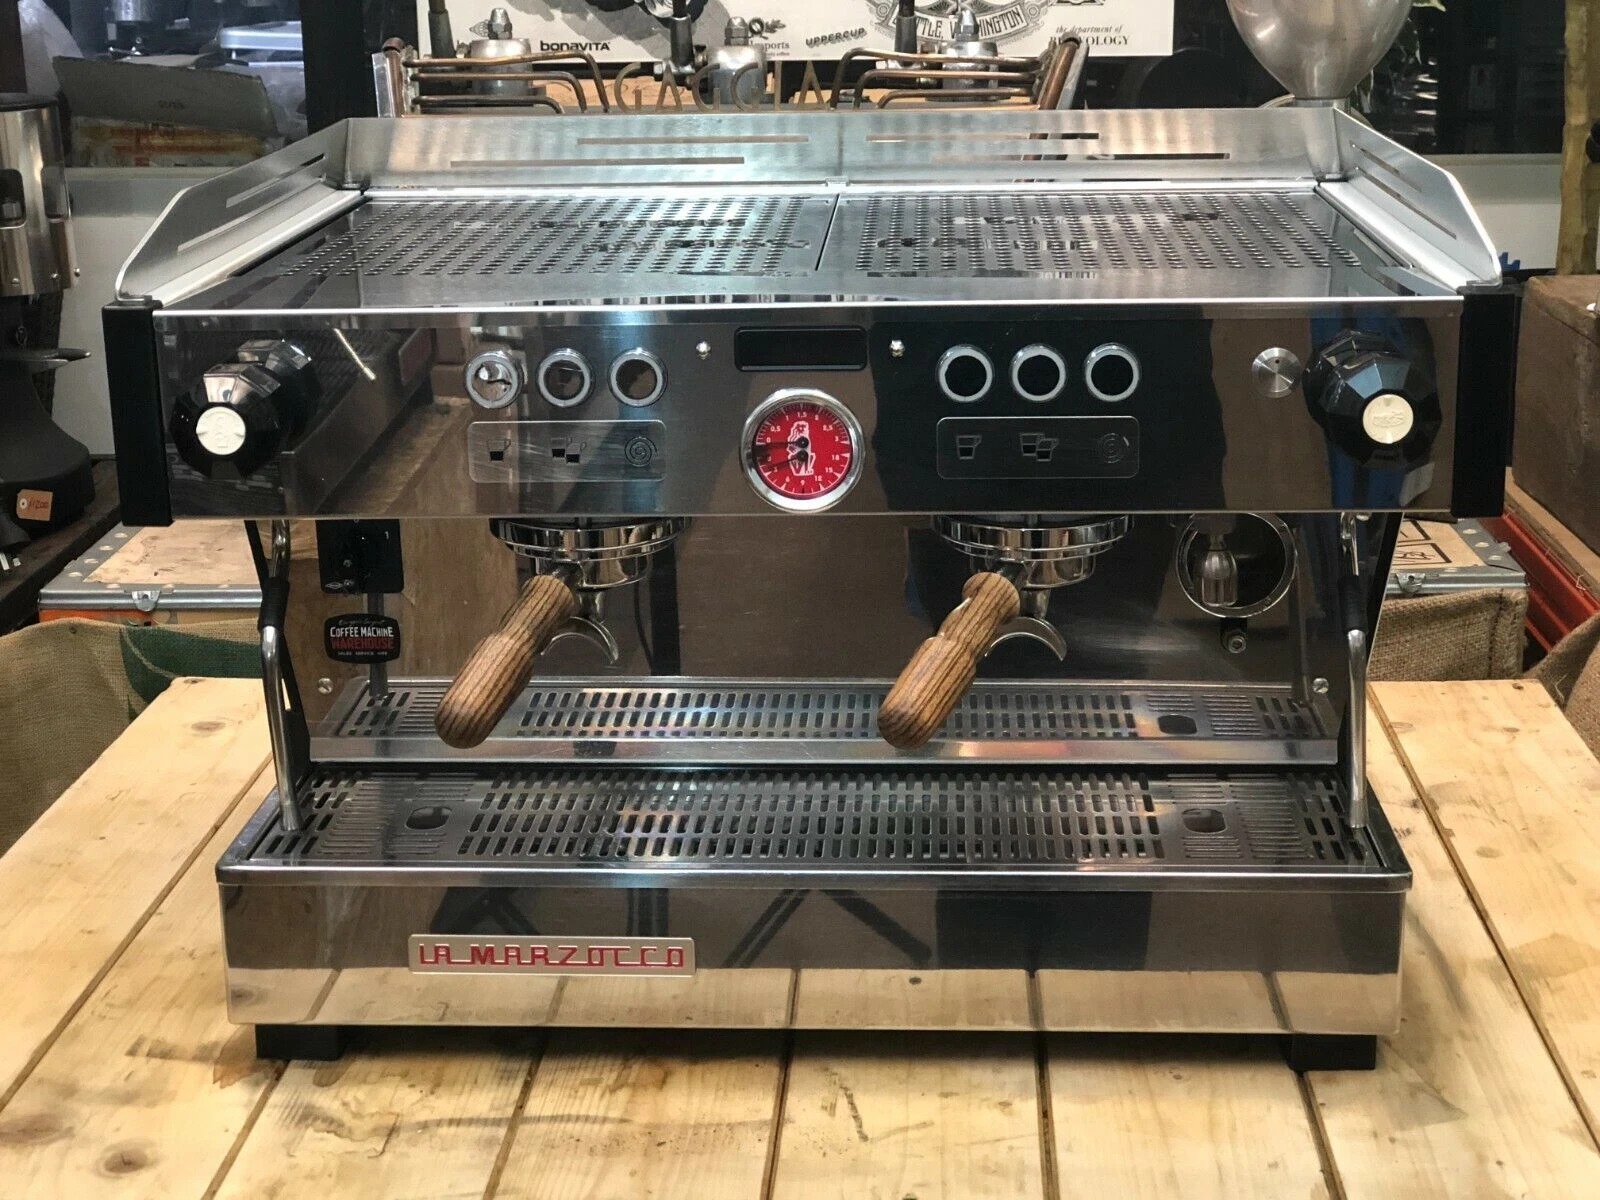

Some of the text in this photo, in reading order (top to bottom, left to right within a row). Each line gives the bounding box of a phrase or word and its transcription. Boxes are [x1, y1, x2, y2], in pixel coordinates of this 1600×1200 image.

[950, 7, 1023, 39] INGTON
[805, 27, 866, 48] UPPERCUP
[330, 626, 394, 637] COFFEE MACHINE
[330, 637, 395, 650] WAREHOUSE
[419, 944, 685, 968] LA MARZOCCO
